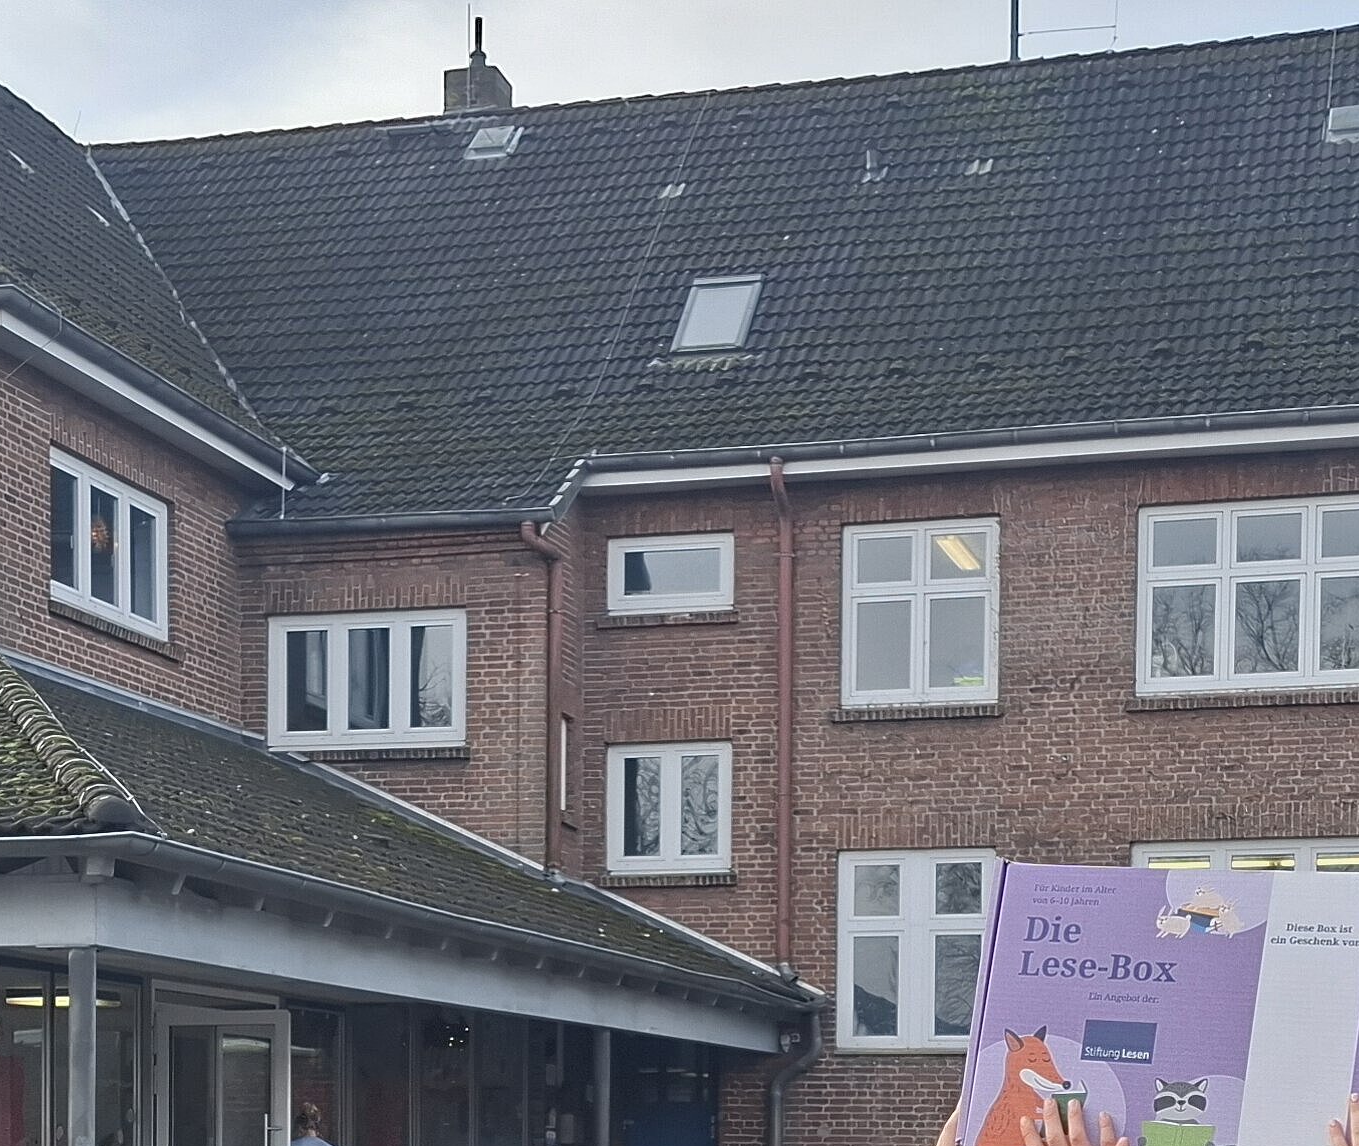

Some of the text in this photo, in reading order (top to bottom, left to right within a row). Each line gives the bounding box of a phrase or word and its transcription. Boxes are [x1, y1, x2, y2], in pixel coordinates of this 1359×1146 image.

[1051, 884, 1080, 893] Kinder
[1082, 884, 1093, 893] im
[1094, 885, 1117, 894] Alter
[1070, 896, 1100, 906] Jahren
[1023, 915, 1082, 944] Die
[1286, 923, 1354, 934] Diese Box ist
[1270, 935, 1287, 945] ein
[1289, 936, 1340, 946] Geschenk
[1018, 950, 1178, 983] Lese-Box
[1088, 991, 1103, 1001] Ein
[1104, 993, 1141, 1004] Angebot
[1084, 1046, 1150, 1061] Stiftung Lesen
